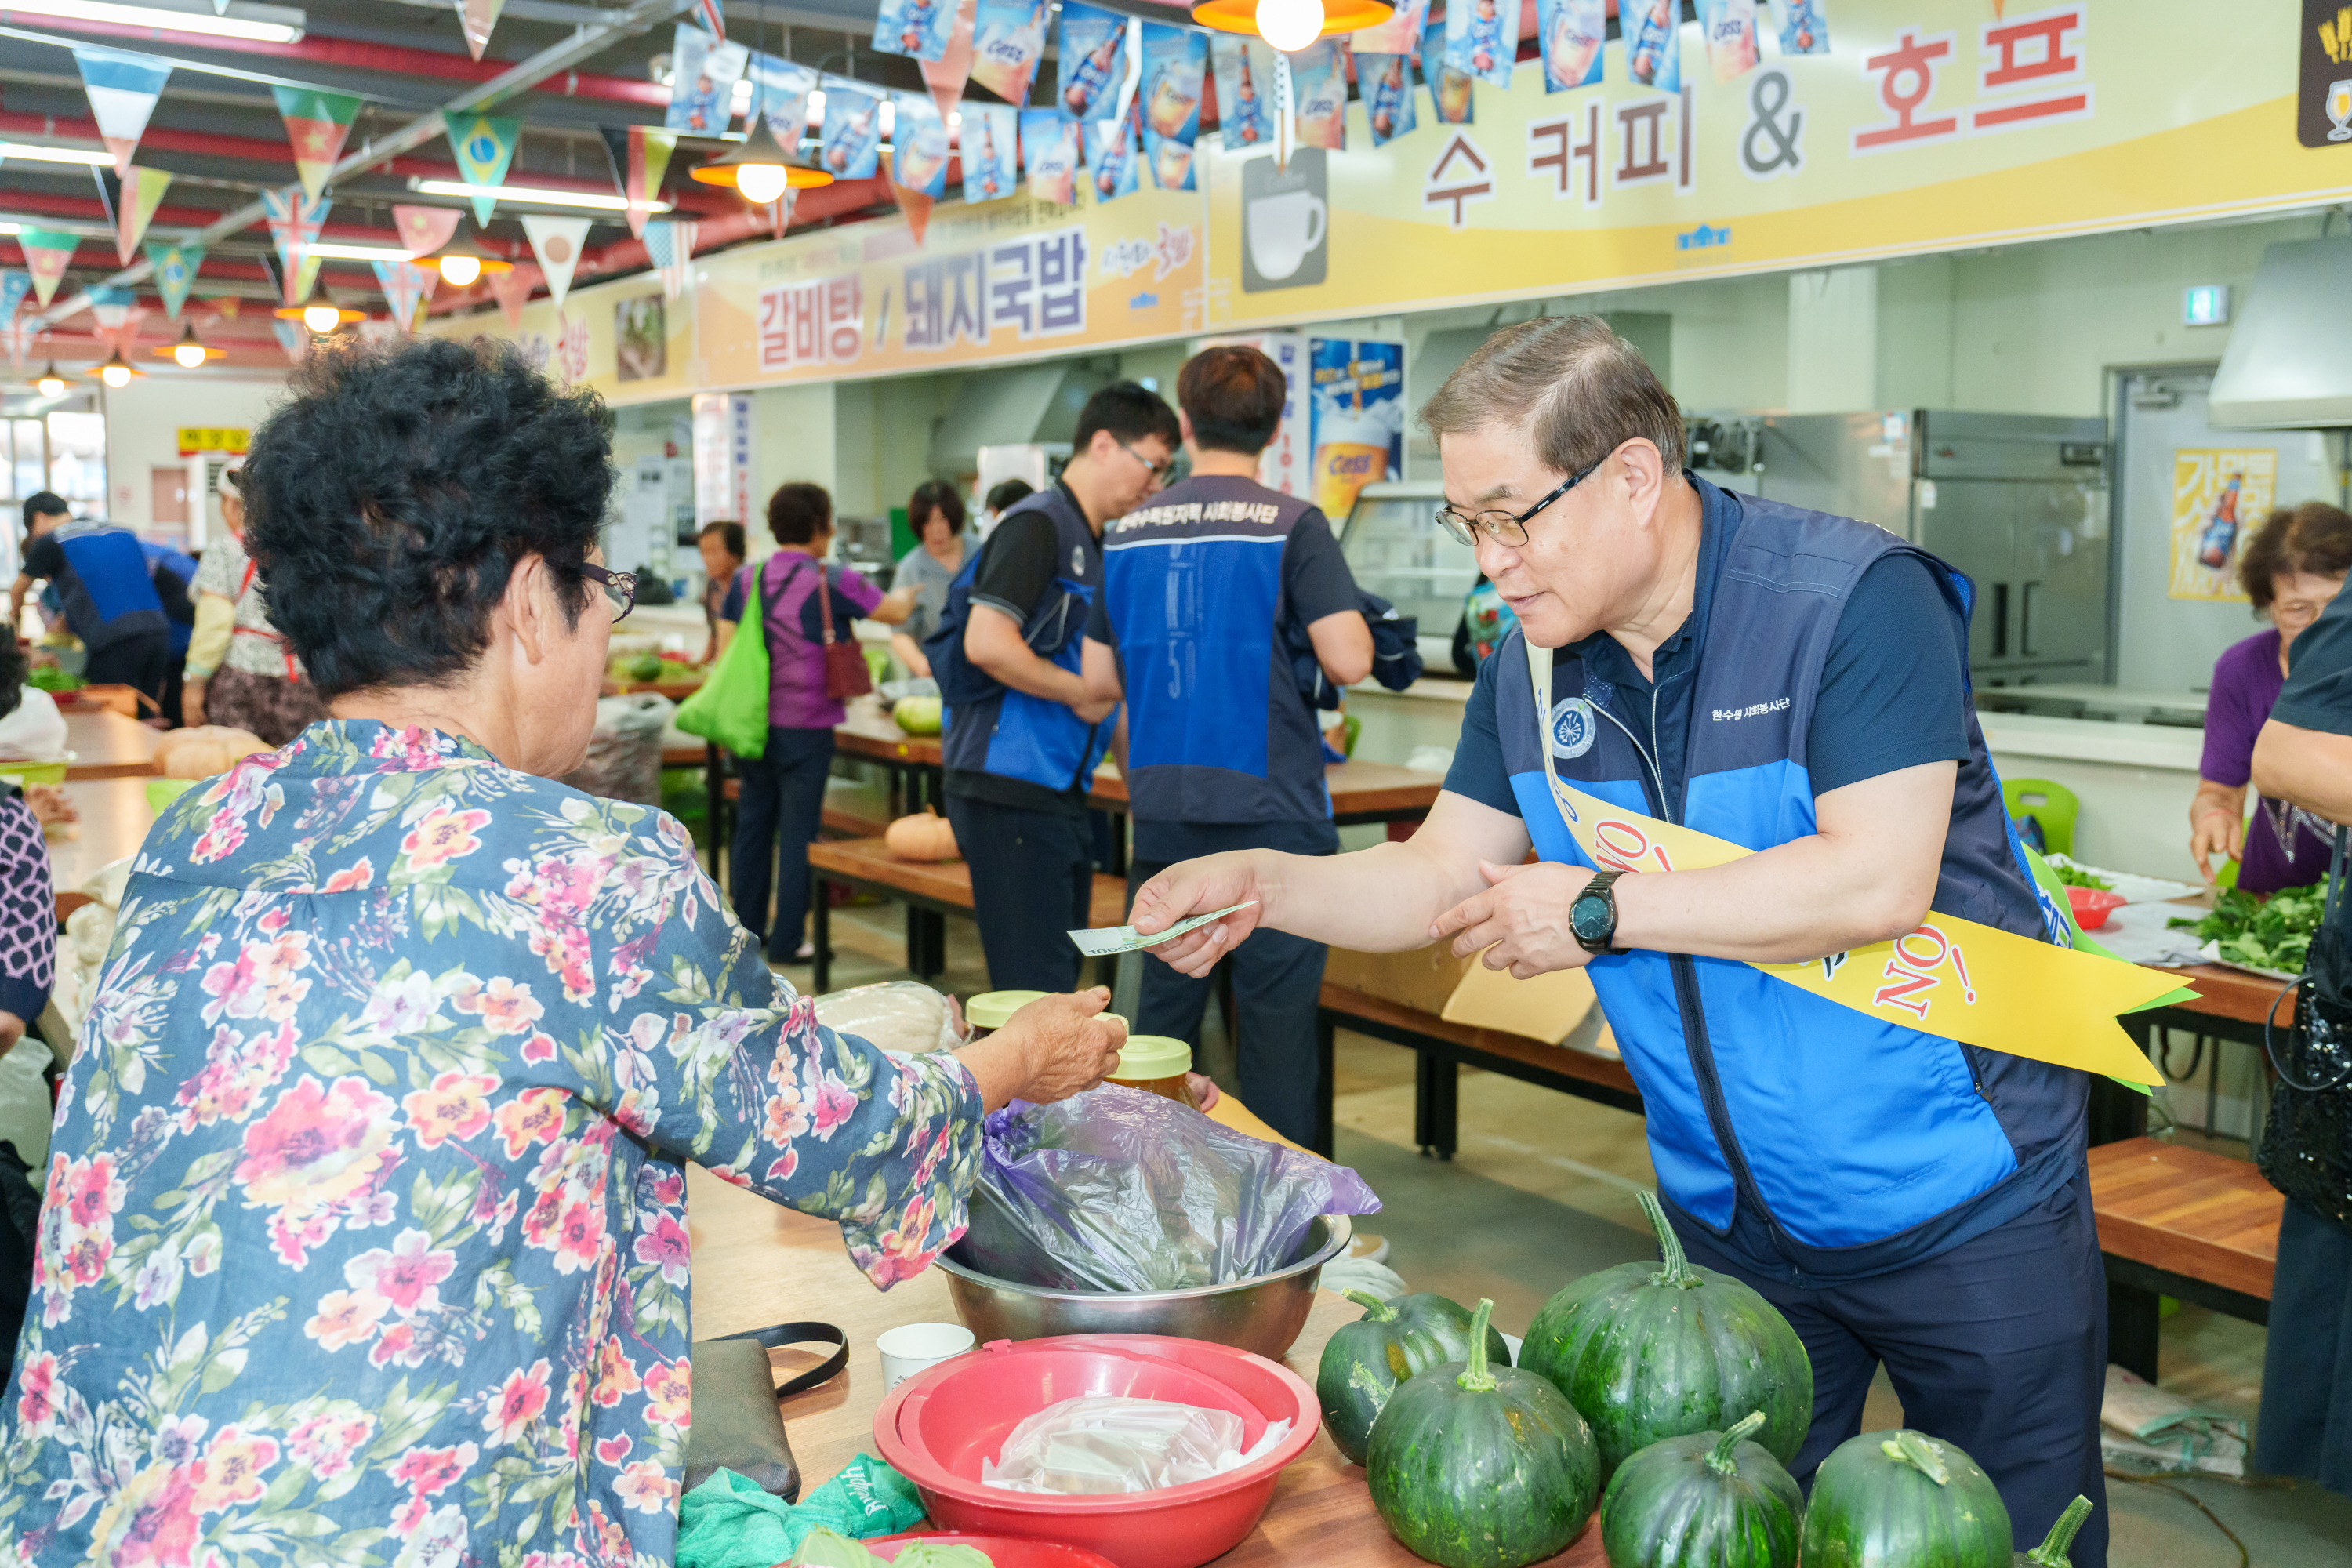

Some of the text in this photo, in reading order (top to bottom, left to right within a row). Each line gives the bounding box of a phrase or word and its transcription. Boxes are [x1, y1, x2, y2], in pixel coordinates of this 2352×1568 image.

[1427, 13, 2086, 226] 수 커피 & 호프
[760, 272, 864, 367] 갈비탕
[876, 285, 891, 350] /
[904, 233, 1085, 347] 돼지국밥
[1711, 696, 1791, 721] 한수원 사회봉사단
[1875, 927, 1974, 1018] NO!
